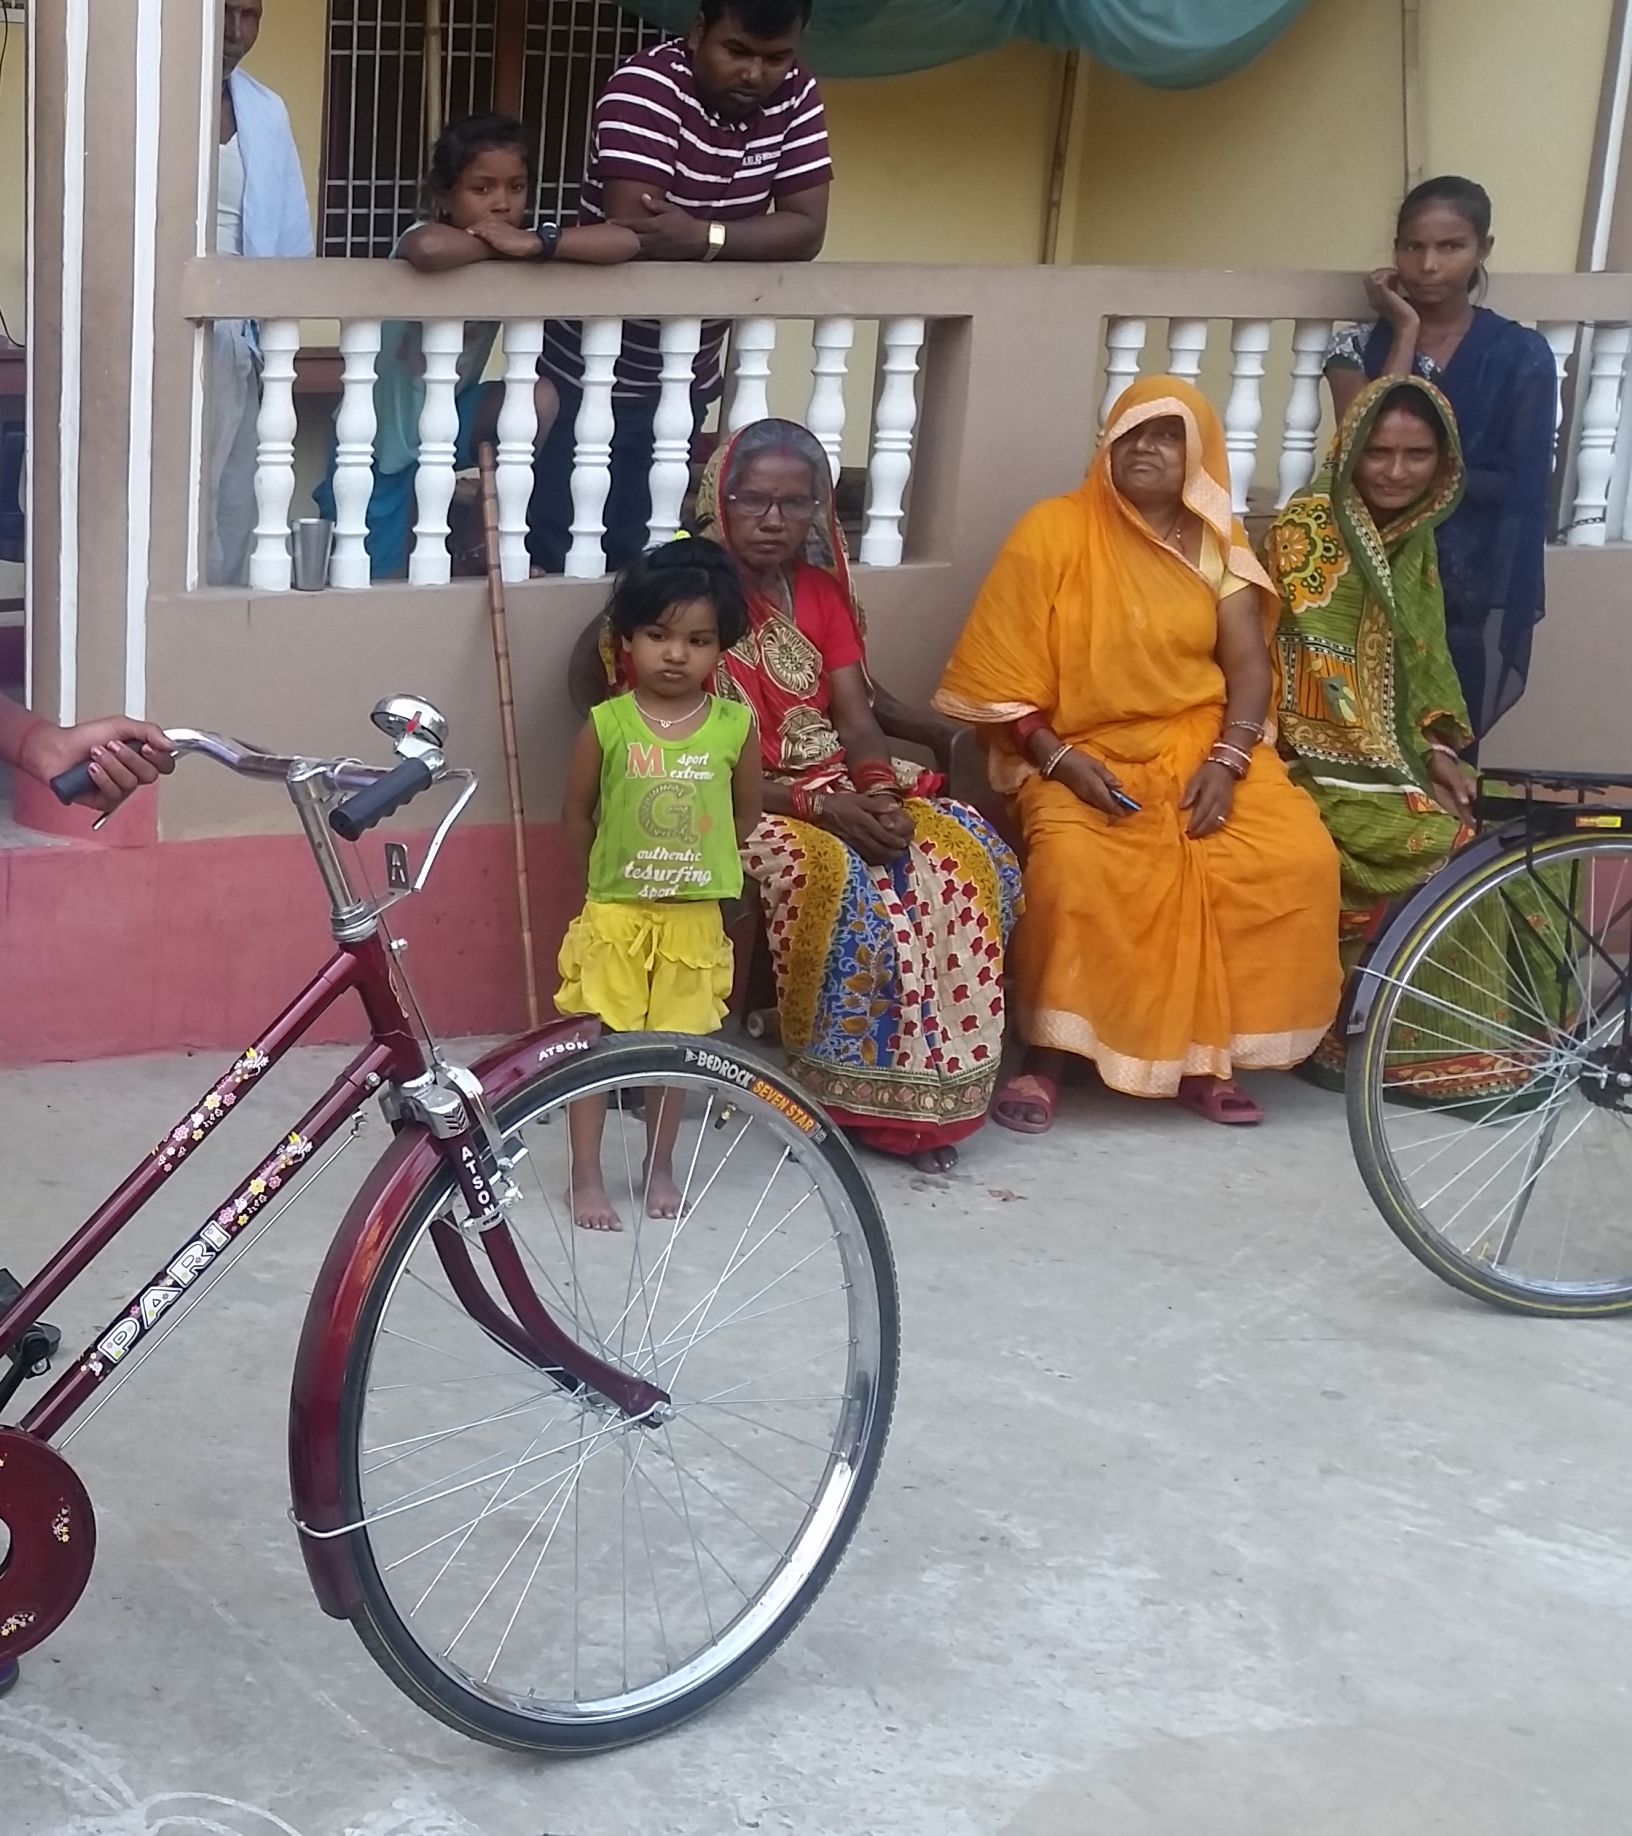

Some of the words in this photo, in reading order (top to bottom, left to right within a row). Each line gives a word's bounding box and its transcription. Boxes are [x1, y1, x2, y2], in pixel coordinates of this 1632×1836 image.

[626, 742, 667, 778] M
[677, 752, 710, 767] sport
[636, 846, 702, 862] authentic
[537, 1040, 589, 1062] ATSON
[696, 1050, 754, 1089] BEDROCK
[753, 1080, 790, 1110] SEVEN
[785, 1105, 815, 1132] STAR
[97, 1220, 231, 1364] PARI
